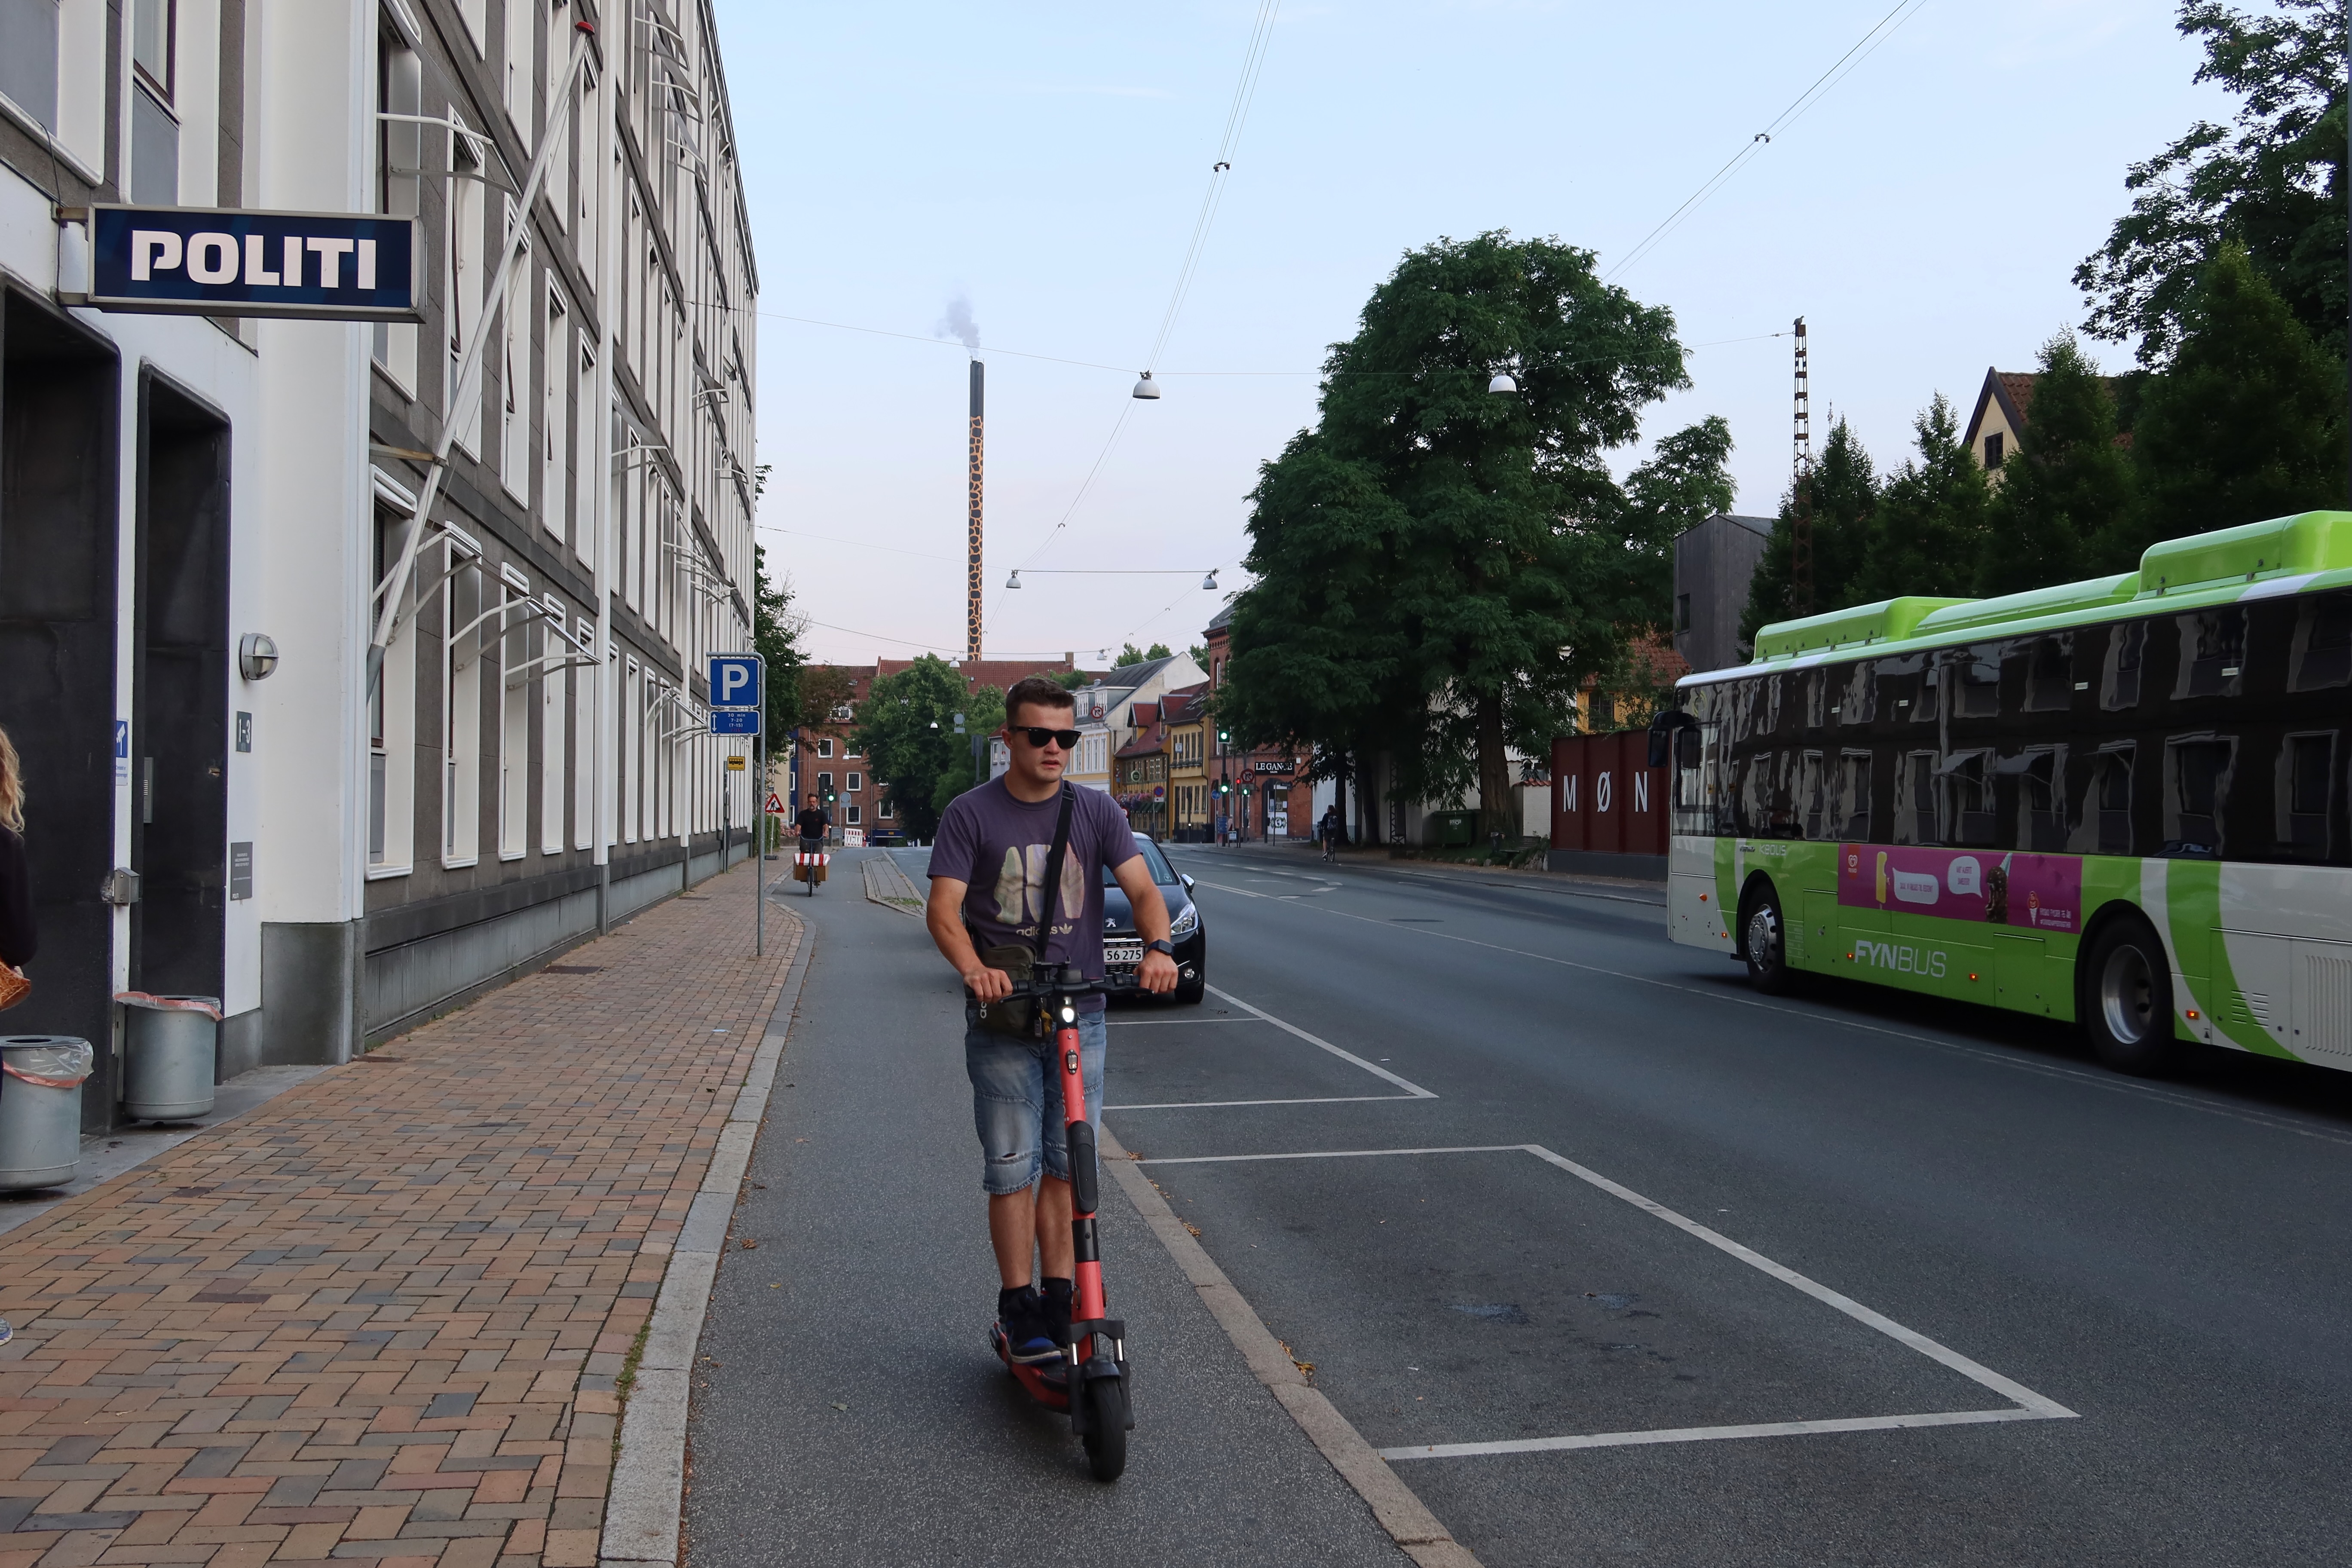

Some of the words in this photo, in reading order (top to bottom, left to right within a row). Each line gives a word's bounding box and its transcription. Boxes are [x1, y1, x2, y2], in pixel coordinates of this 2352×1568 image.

[131, 230, 377, 290] POLITI
[723, 664, 749, 701] P
[239, 718, 251, 744] 1-3
[1016, 925, 1058, 937] adis
[1107, 950, 1120, 961] 56
[1122, 949, 1142, 960] 275
[1854, 940, 1947, 978] FYNBUS
